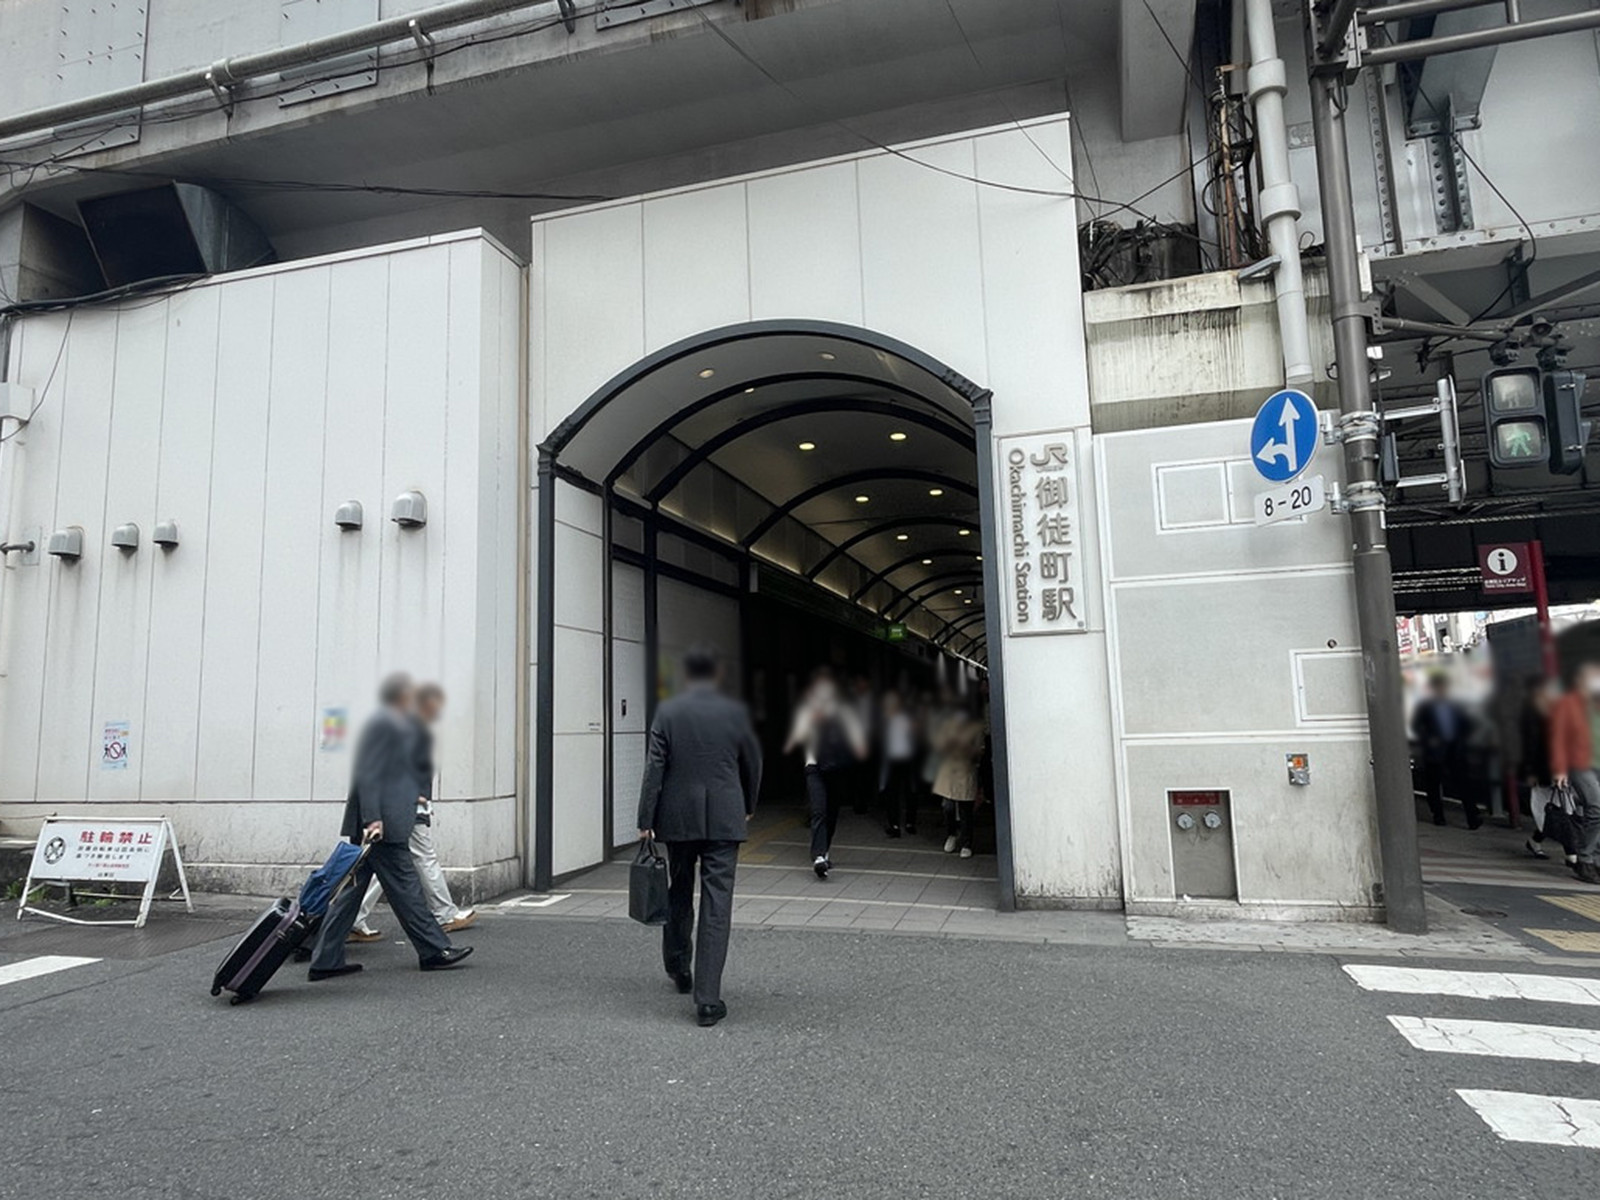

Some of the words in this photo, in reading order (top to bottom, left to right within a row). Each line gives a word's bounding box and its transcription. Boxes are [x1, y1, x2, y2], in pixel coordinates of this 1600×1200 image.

[1008, 448, 1030, 558] Okachimachi
[1015, 561, 1033, 623] Station
[80, 831, 153, 844] 駐輪禁止
